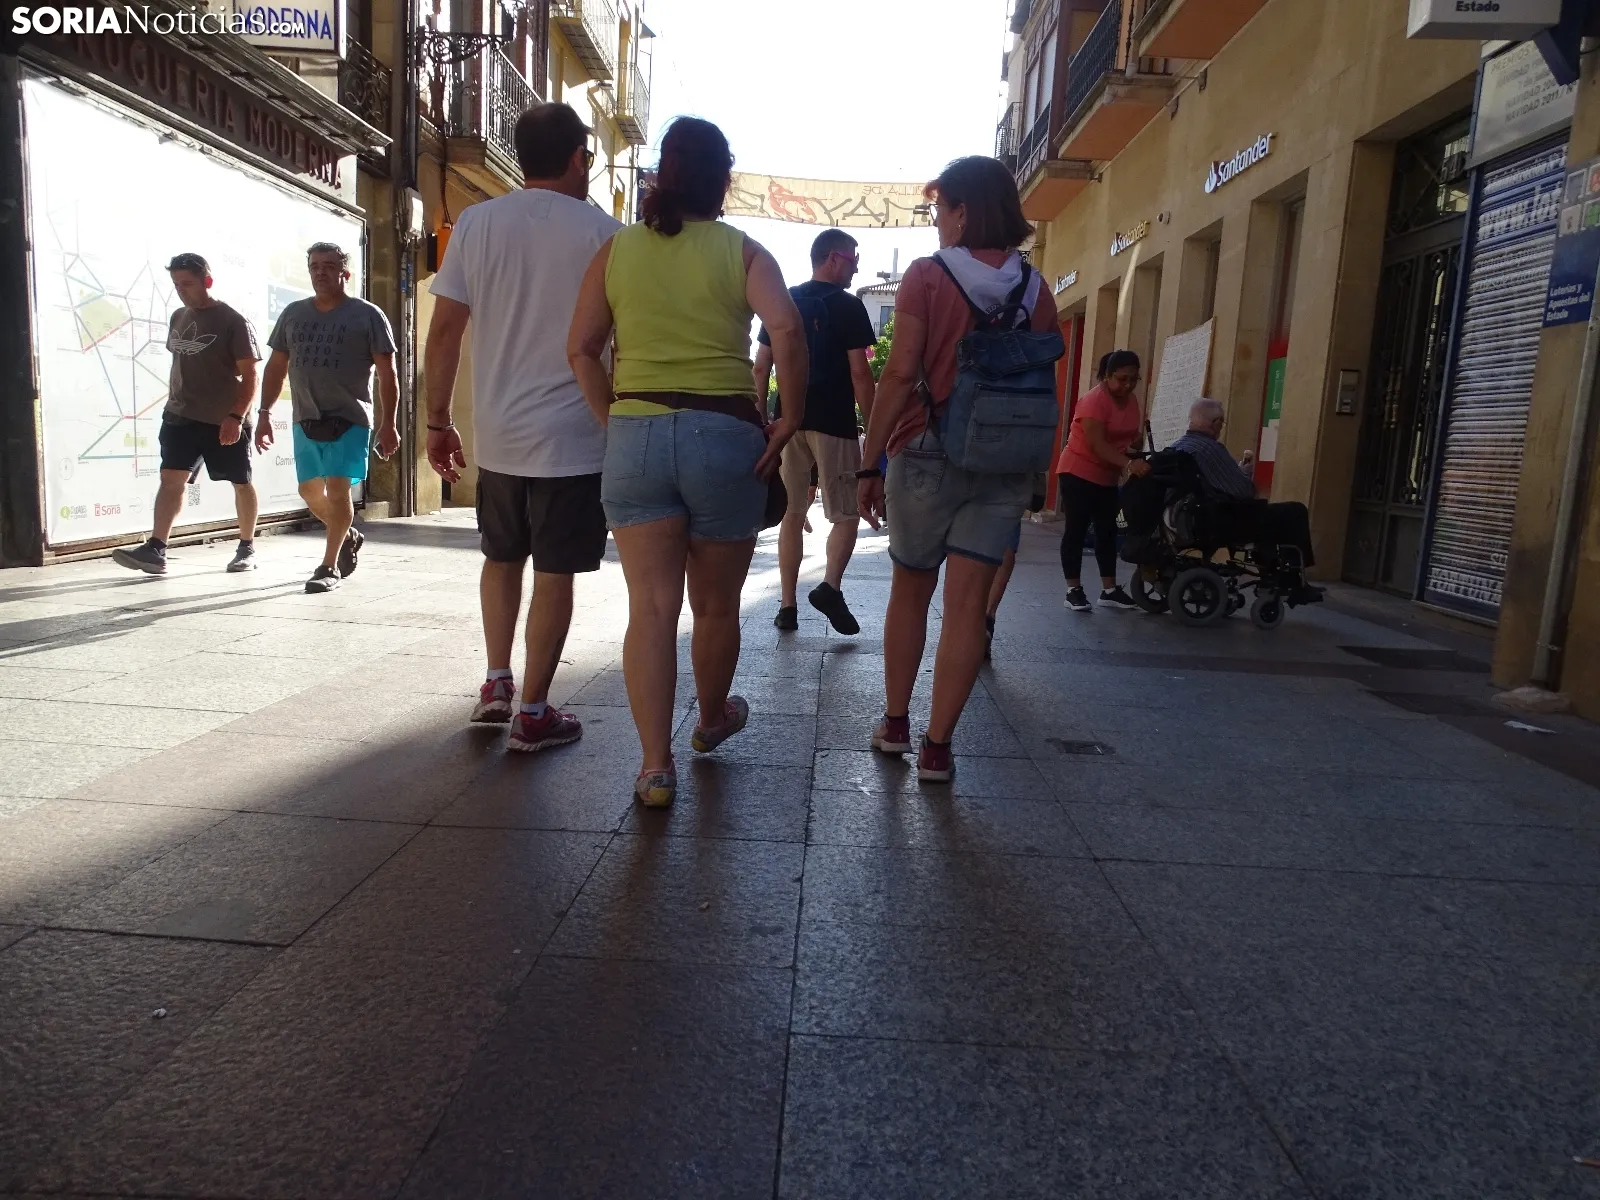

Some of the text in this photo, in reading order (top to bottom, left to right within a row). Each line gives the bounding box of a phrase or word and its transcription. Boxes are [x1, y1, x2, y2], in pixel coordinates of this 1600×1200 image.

[1455, 0, 1501, 12] Estado
[246, 104, 343, 190] MODERNA
[1216, 131, 1273, 187] Santander
[1116, 220, 1148, 254] Santander
[293, 321, 347, 333] BERLIN
